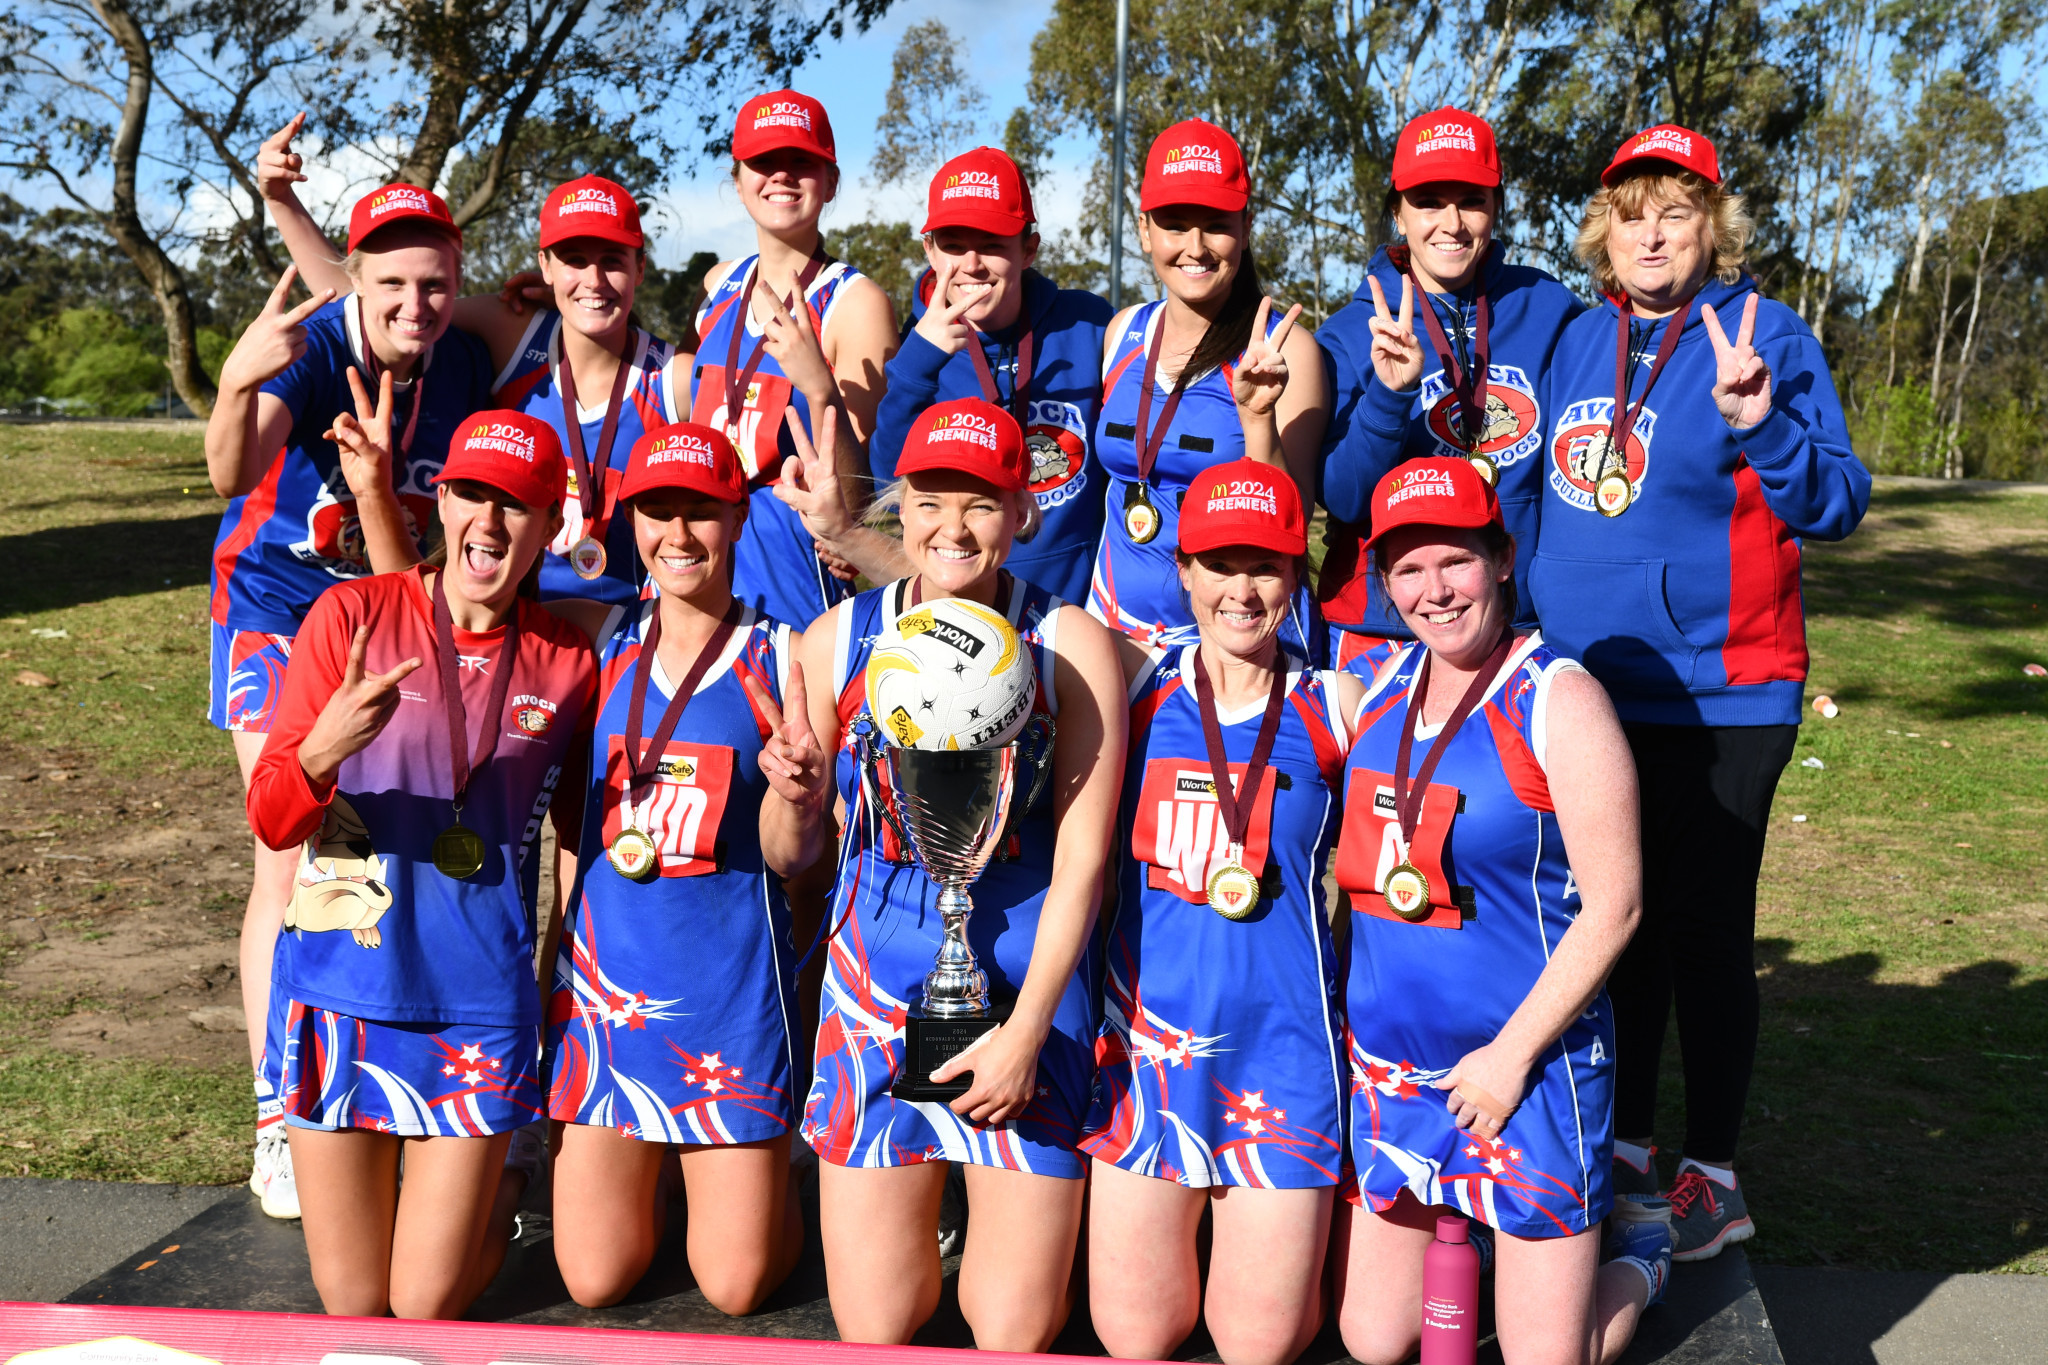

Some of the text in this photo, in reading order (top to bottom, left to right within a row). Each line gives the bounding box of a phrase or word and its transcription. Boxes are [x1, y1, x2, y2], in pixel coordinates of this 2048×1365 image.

[772, 102, 810, 120] 2024
[754, 115, 811, 131] PREMIERS
[1434, 124, 1475, 141] 2024
[1650, 130, 1692, 148] 2024
[1181, 144, 1221, 163] 2024
[1416, 137, 1476, 156] PREMIERS
[1632, 140, 1692, 156] PREMIERS
[1162, 160, 1222, 176] PREMIERS
[960, 172, 1000, 190] 2024
[386, 189, 428, 205] 2024
[577, 188, 616, 206] 2024
[942, 186, 1000, 201] PREMIERS
[370, 199, 430, 218] PREMIERS
[558, 201, 618, 216] PREMIERS
[950, 413, 998, 438] 2024
[488, 424, 536, 450] 2024
[668, 435, 714, 456] 2024
[927, 428, 997, 450] PREMIERS
[464, 436, 534, 462] PREMIERS
[646, 449, 714, 468] PREMIERS
[1404, 468, 1453, 486] 2024
[1230, 481, 1276, 503] 2024
[1387, 484, 1455, 511] PREMIERS
[1207, 497, 1277, 516] PREMIERS
[901, 616, 975, 654] Work Safe
[512, 694, 557, 714] AVOCA
[894, 712, 911, 744] Safe
[672, 764, 690, 776] Safe
[1181, 780, 1208, 790] Work
[1378, 795, 1396, 808] Wor
